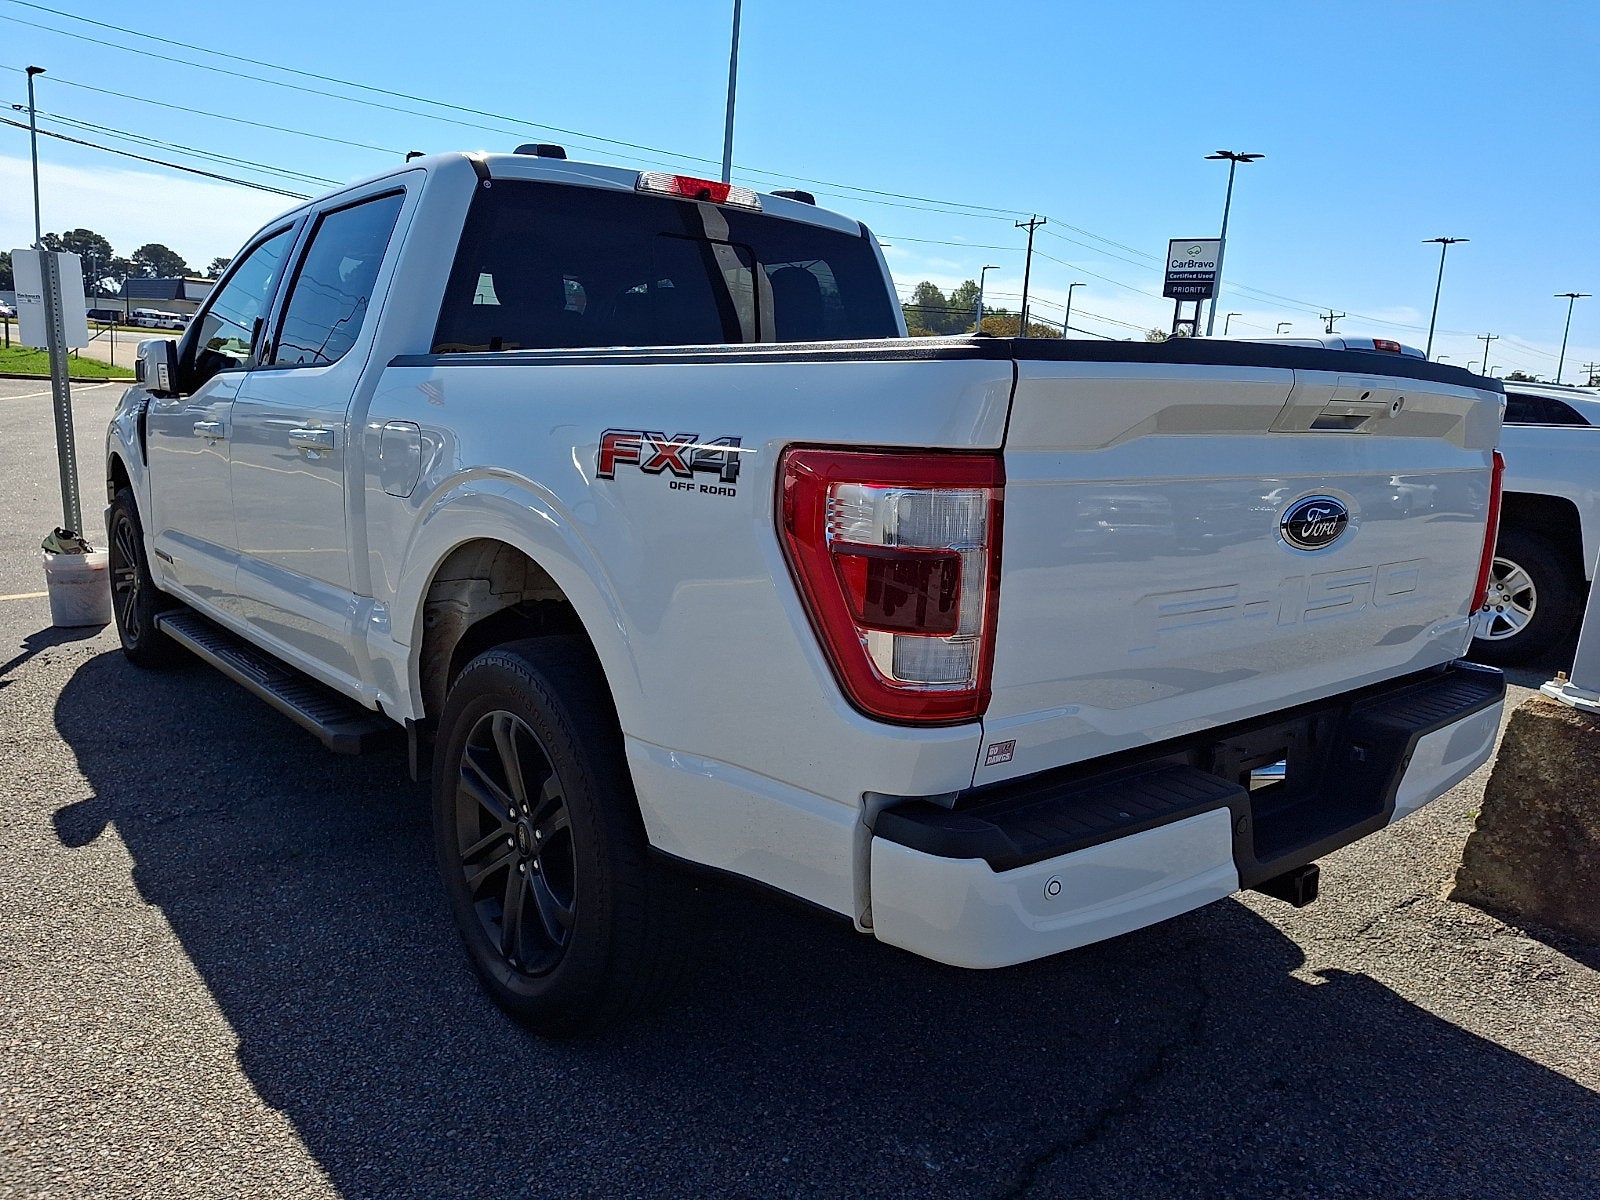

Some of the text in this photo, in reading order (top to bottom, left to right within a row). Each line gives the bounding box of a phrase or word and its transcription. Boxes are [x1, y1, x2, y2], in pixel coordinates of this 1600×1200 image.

[1171, 259, 1214, 268] CarBravo
[595, 428, 742, 484] FX4
[669, 480, 737, 497] OFF ROAD
[1301, 507, 1338, 538] Ford
[1127, 557, 1430, 654] F-150
[989, 747, 999, 755] GO
